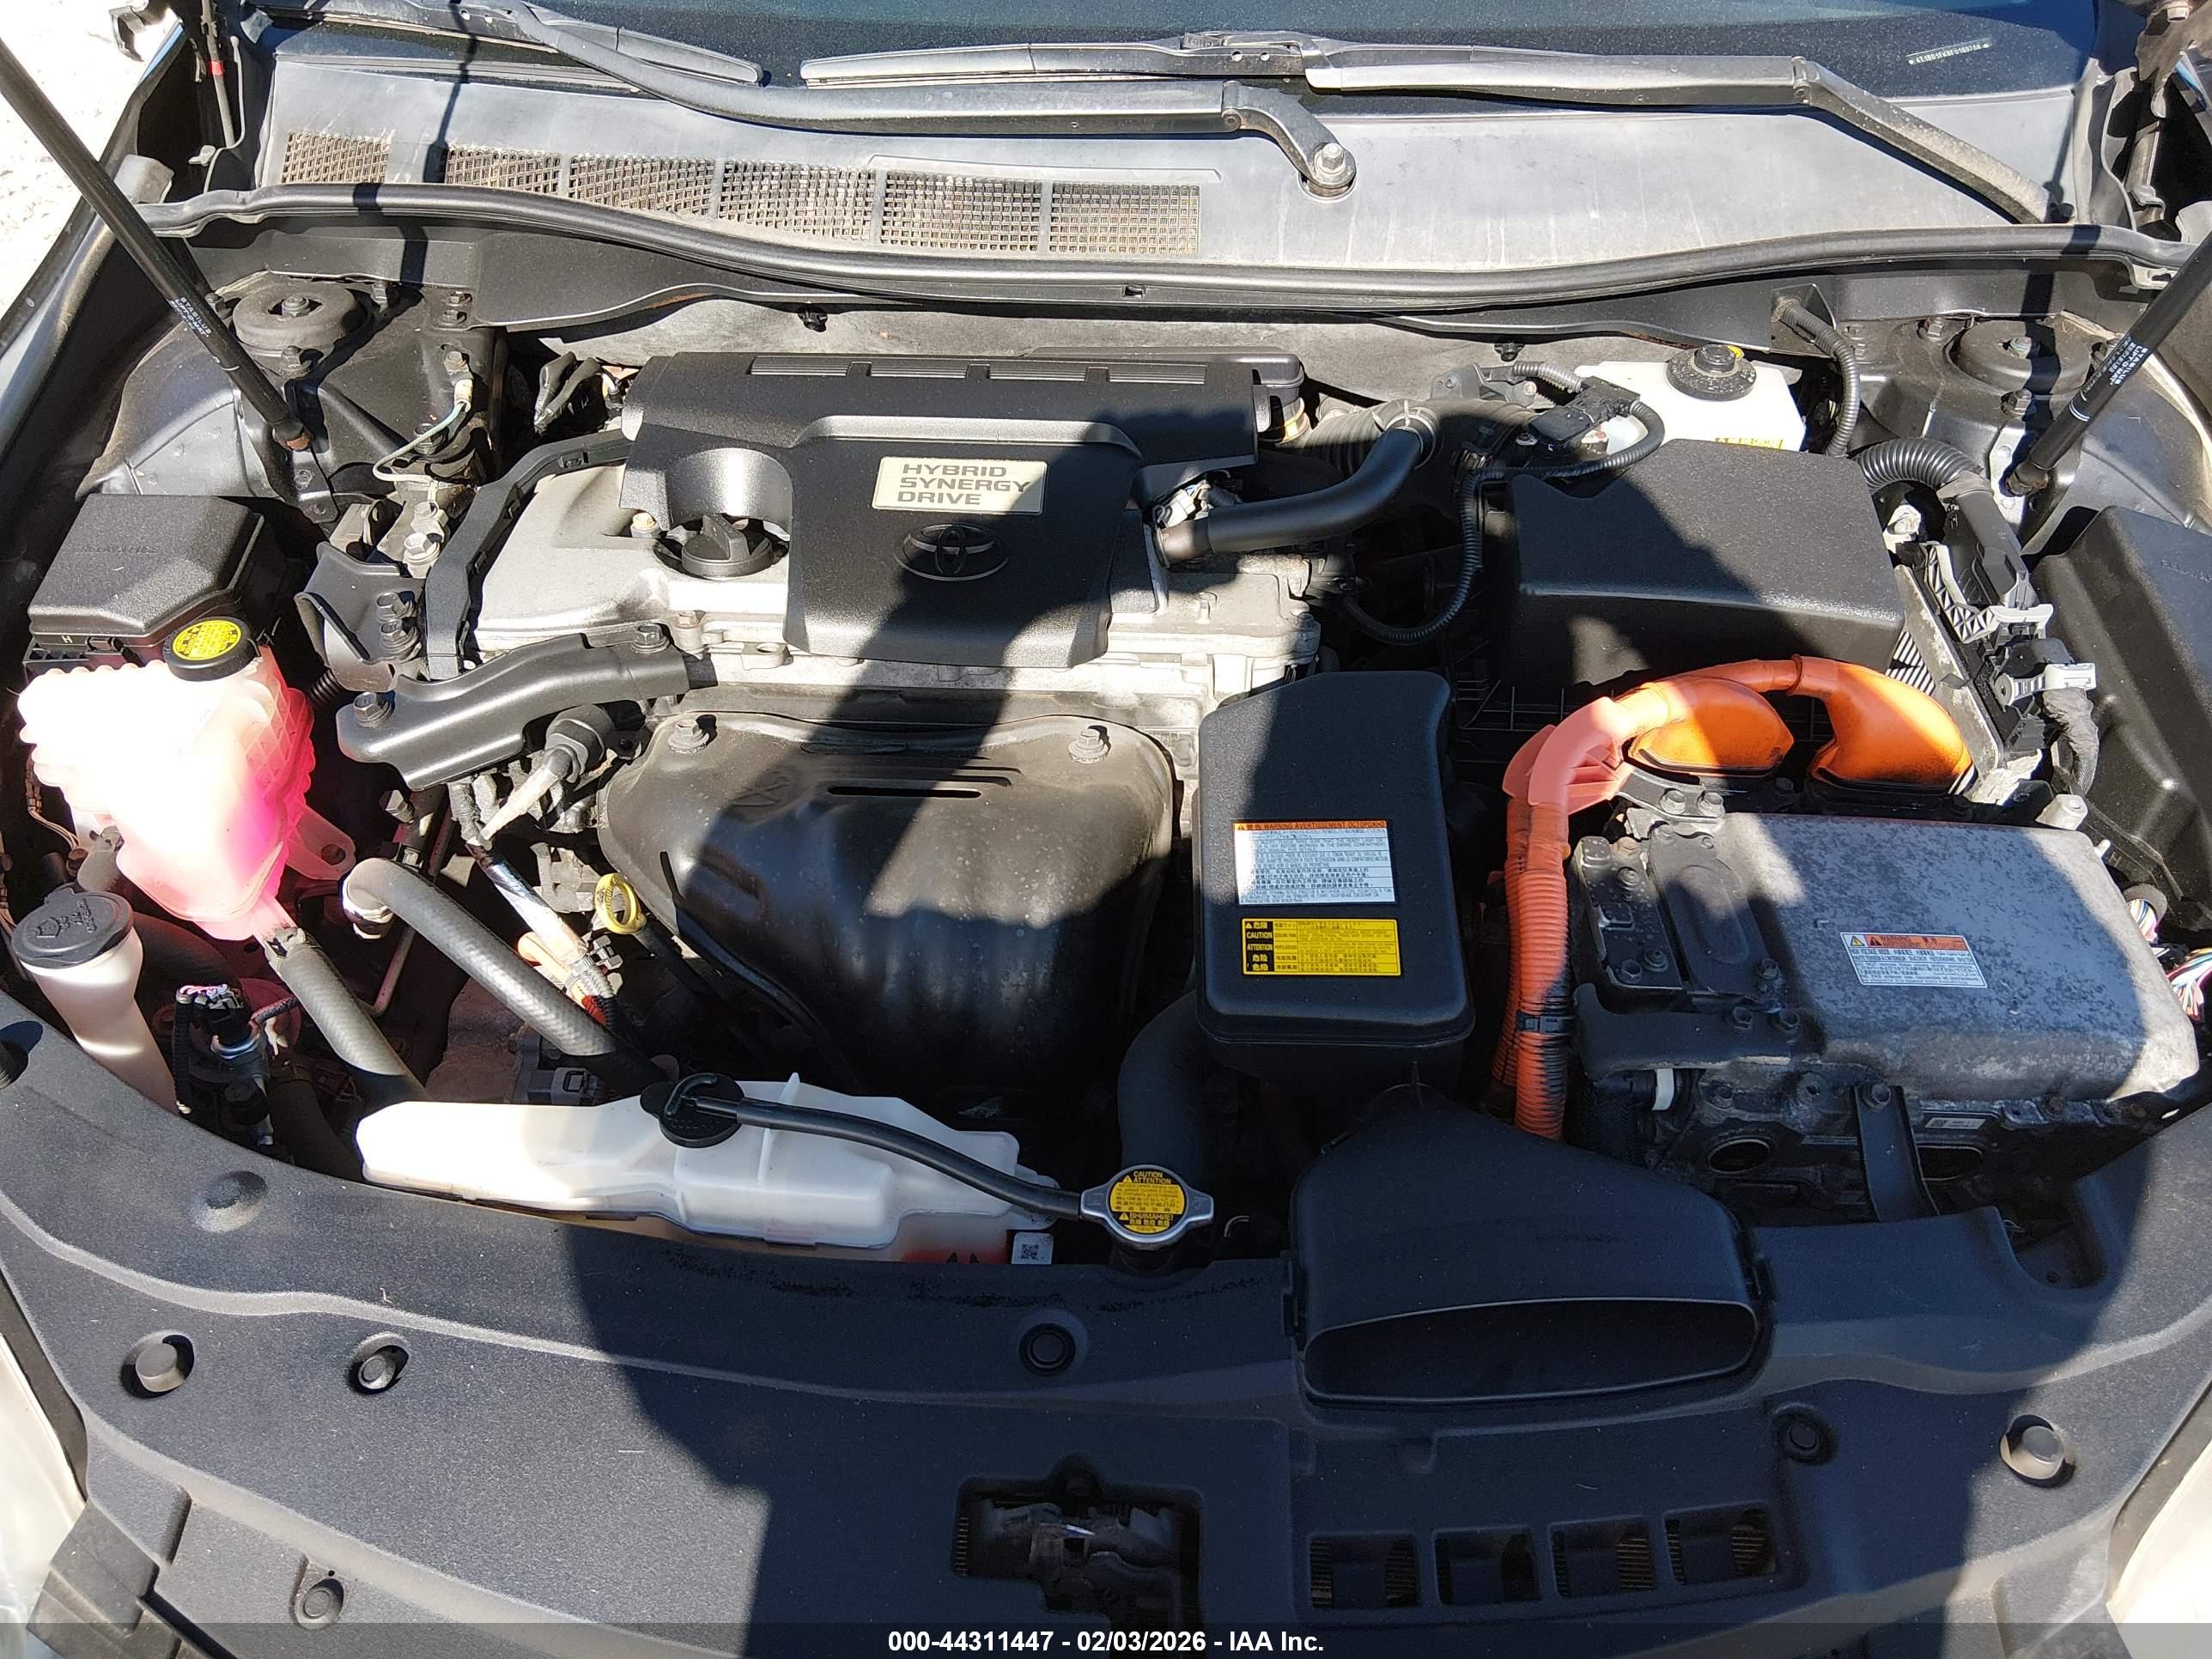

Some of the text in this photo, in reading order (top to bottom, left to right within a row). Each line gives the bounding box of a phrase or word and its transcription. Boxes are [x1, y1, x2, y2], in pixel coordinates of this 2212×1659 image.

[179, 297, 211, 334] STABILUS
[2114, 347, 2148, 385] STABILUS
[902, 464, 1006, 477] HYBRID
[899, 477, 1031, 492] SYNERGY
[896, 491, 981, 505] DRIVE
